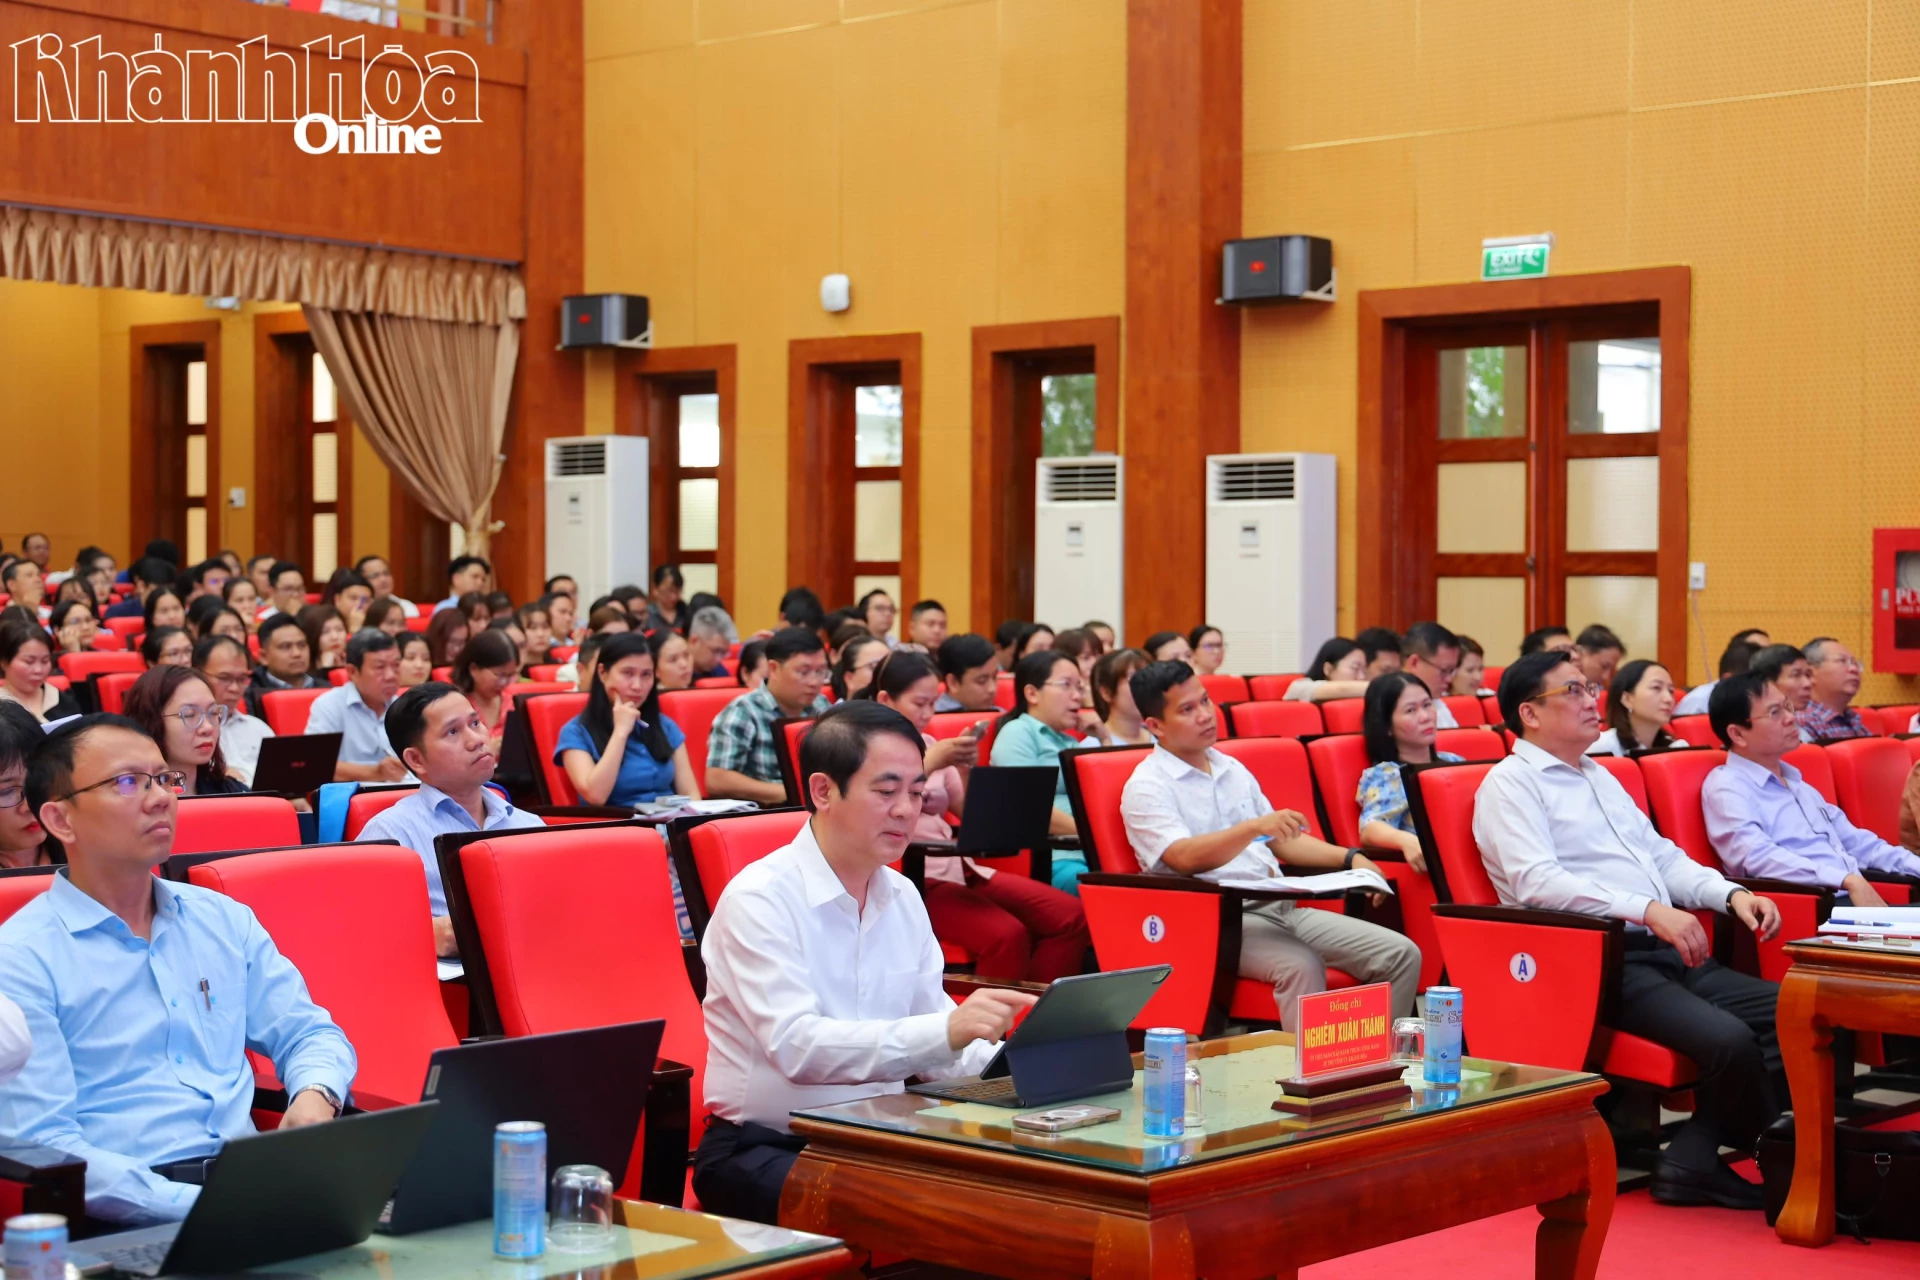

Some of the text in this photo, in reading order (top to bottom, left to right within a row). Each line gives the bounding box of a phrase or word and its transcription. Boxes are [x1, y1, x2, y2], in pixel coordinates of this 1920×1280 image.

[1490, 248, 1527, 268] EXIT
[1149, 921, 1158, 936] B
[1518, 959, 1528, 976] A
[1304, 1020, 1336, 1049] NGHIÊM
[1337, 1016, 1359, 1043] XUÂN
